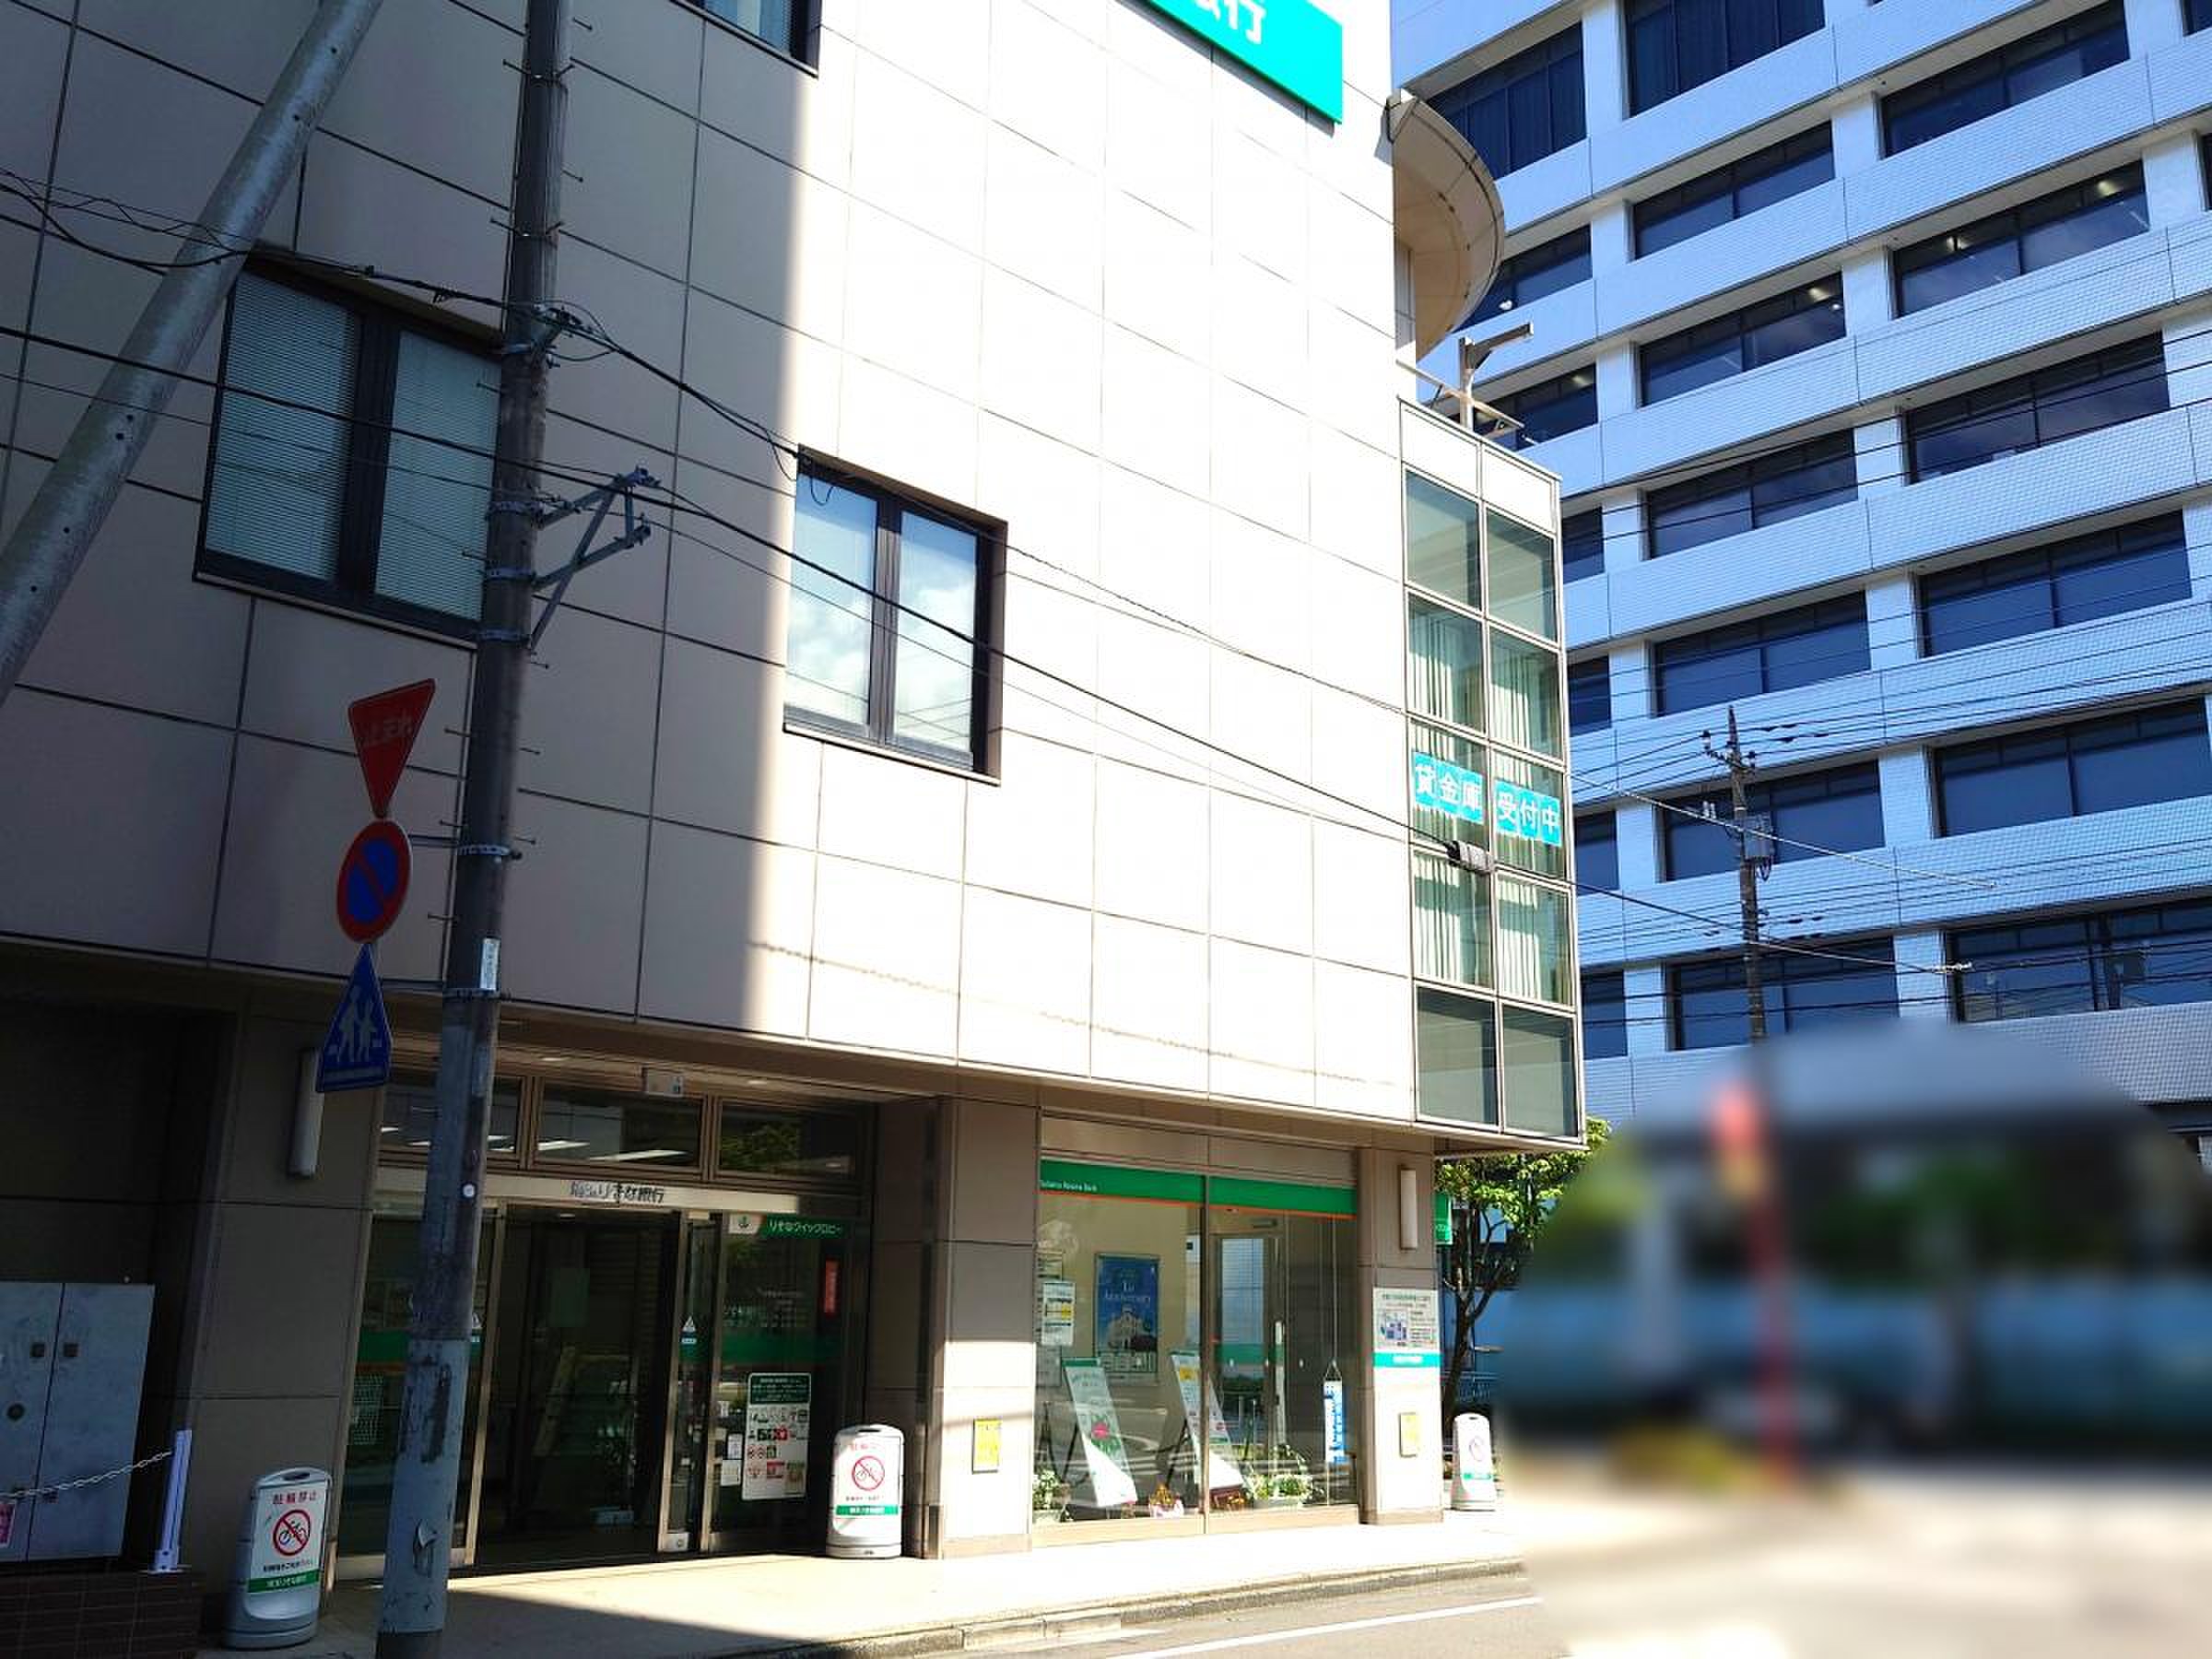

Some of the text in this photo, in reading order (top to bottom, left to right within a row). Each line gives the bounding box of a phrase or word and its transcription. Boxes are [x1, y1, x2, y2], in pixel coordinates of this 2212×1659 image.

[1194, 0, 1267, 45] 行
[1414, 763, 1559, 835] 貸金庫 受付中
